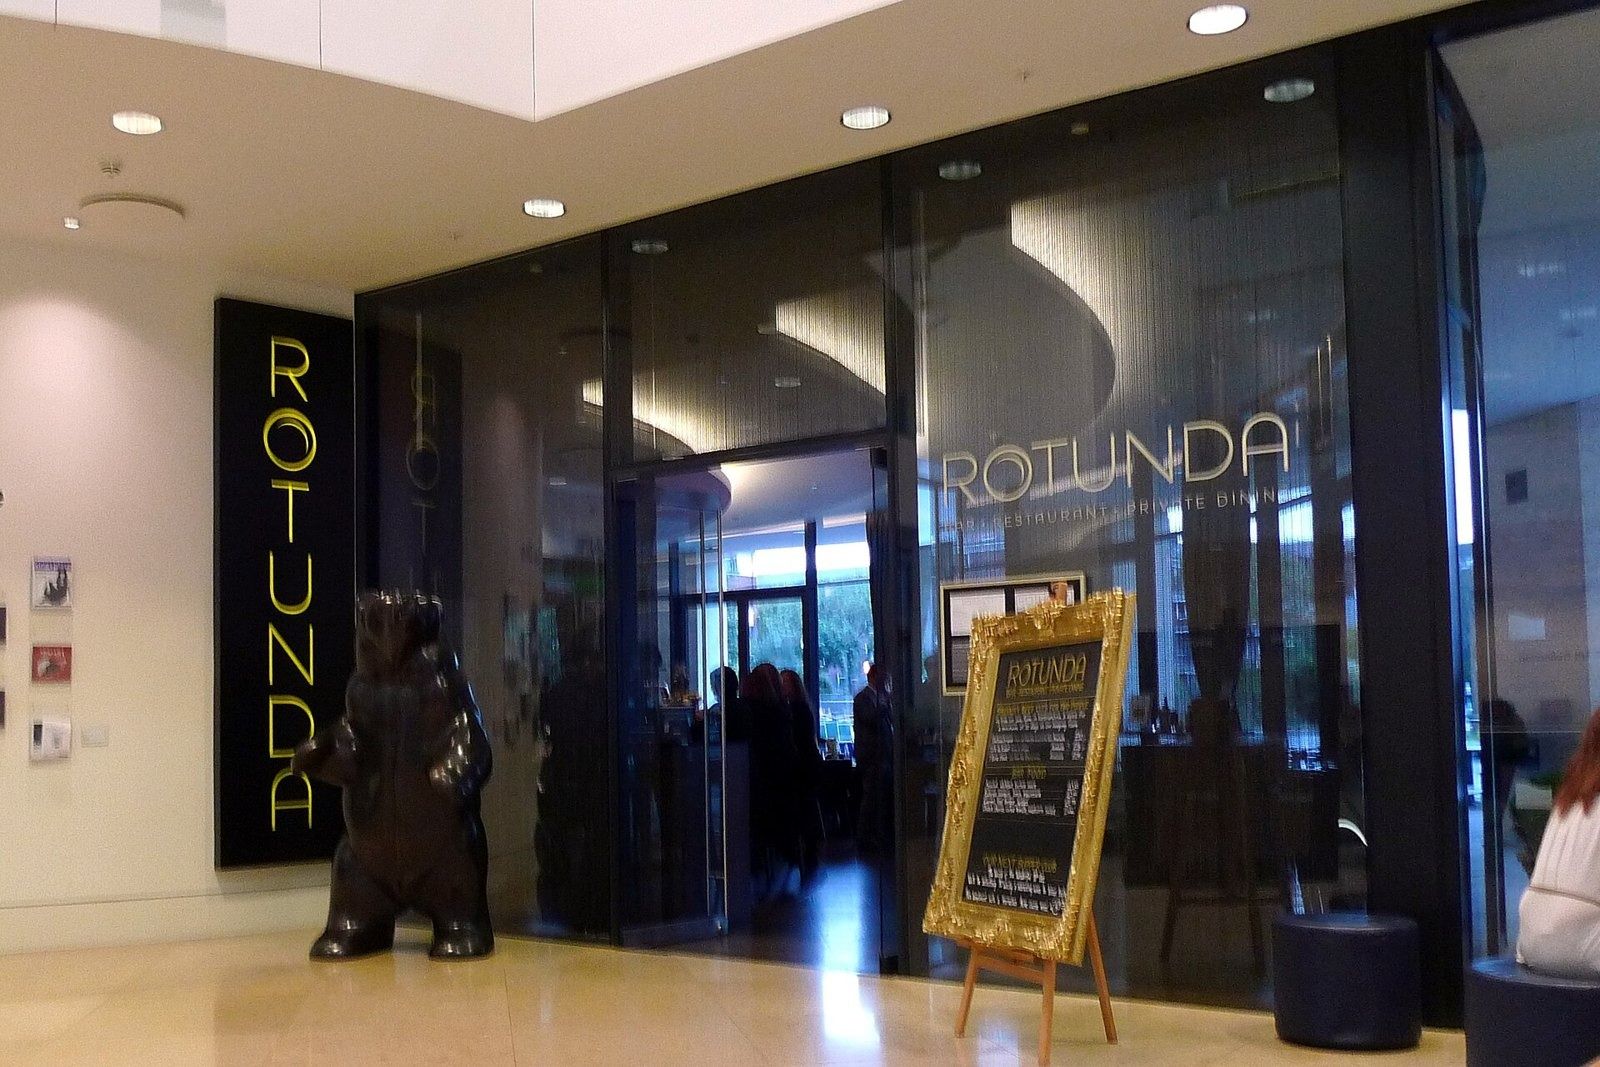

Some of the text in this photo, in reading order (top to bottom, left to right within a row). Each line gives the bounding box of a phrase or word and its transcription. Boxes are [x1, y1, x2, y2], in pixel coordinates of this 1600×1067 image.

[943, 412, 1290, 507] ROTUNDA
[1216, 486, 1279, 508] DININ
[263, 336, 317, 832] ROTUNDA
[1006, 653, 1088, 688] ROTUNDA
